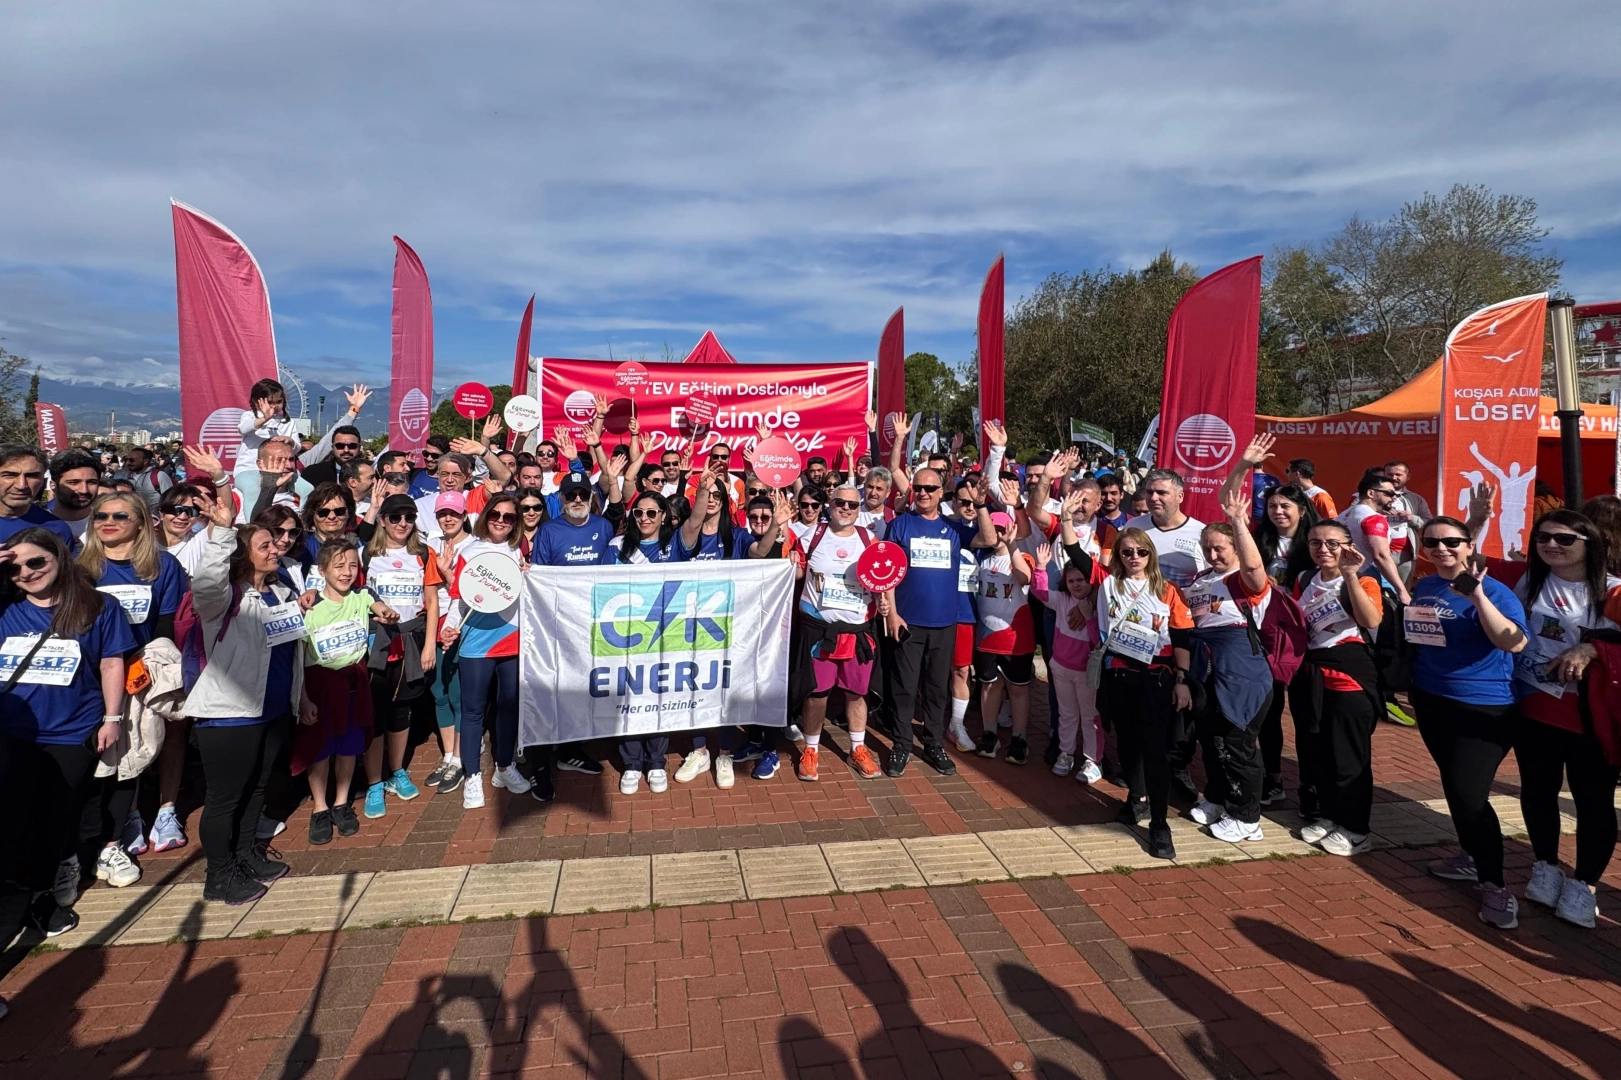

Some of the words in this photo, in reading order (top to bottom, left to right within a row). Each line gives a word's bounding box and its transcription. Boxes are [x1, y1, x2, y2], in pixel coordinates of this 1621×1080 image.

[737, 382, 828, 399] Dostlarıyla
[1454, 388, 1503, 400] KOŞAR
[1455, 402, 1537, 421] LÖSEV
[1267, 420, 1317, 435] LÖSEV
[1322, 421, 1382, 435] HAYAT
[650, 431, 690, 451] Dur
[784, 430, 827, 453] Yok
[1181, 444, 1229, 458] TEV
[759, 455, 794, 463] Eğitimde
[1189, 486, 1214, 494] 1967
[464, 567, 480, 578] Dur
[476, 564, 512, 592] Eğitimde
[859, 573, 875, 590] BAĞIŞ
[875, 577, 900, 591] GELİNCE
[897, 566, 906, 579] BİZ
[381, 585, 421, 593] 10602
[1188, 594, 1210, 605] 0624
[1306, 601, 1338, 622] 0616
[265, 615, 300, 632] 10610
[1407, 622, 1444, 634] 13094
[319, 627, 365, 648] 10555
[1114, 632, 1153, 651] 10625
[644, 704, 659, 712] an
